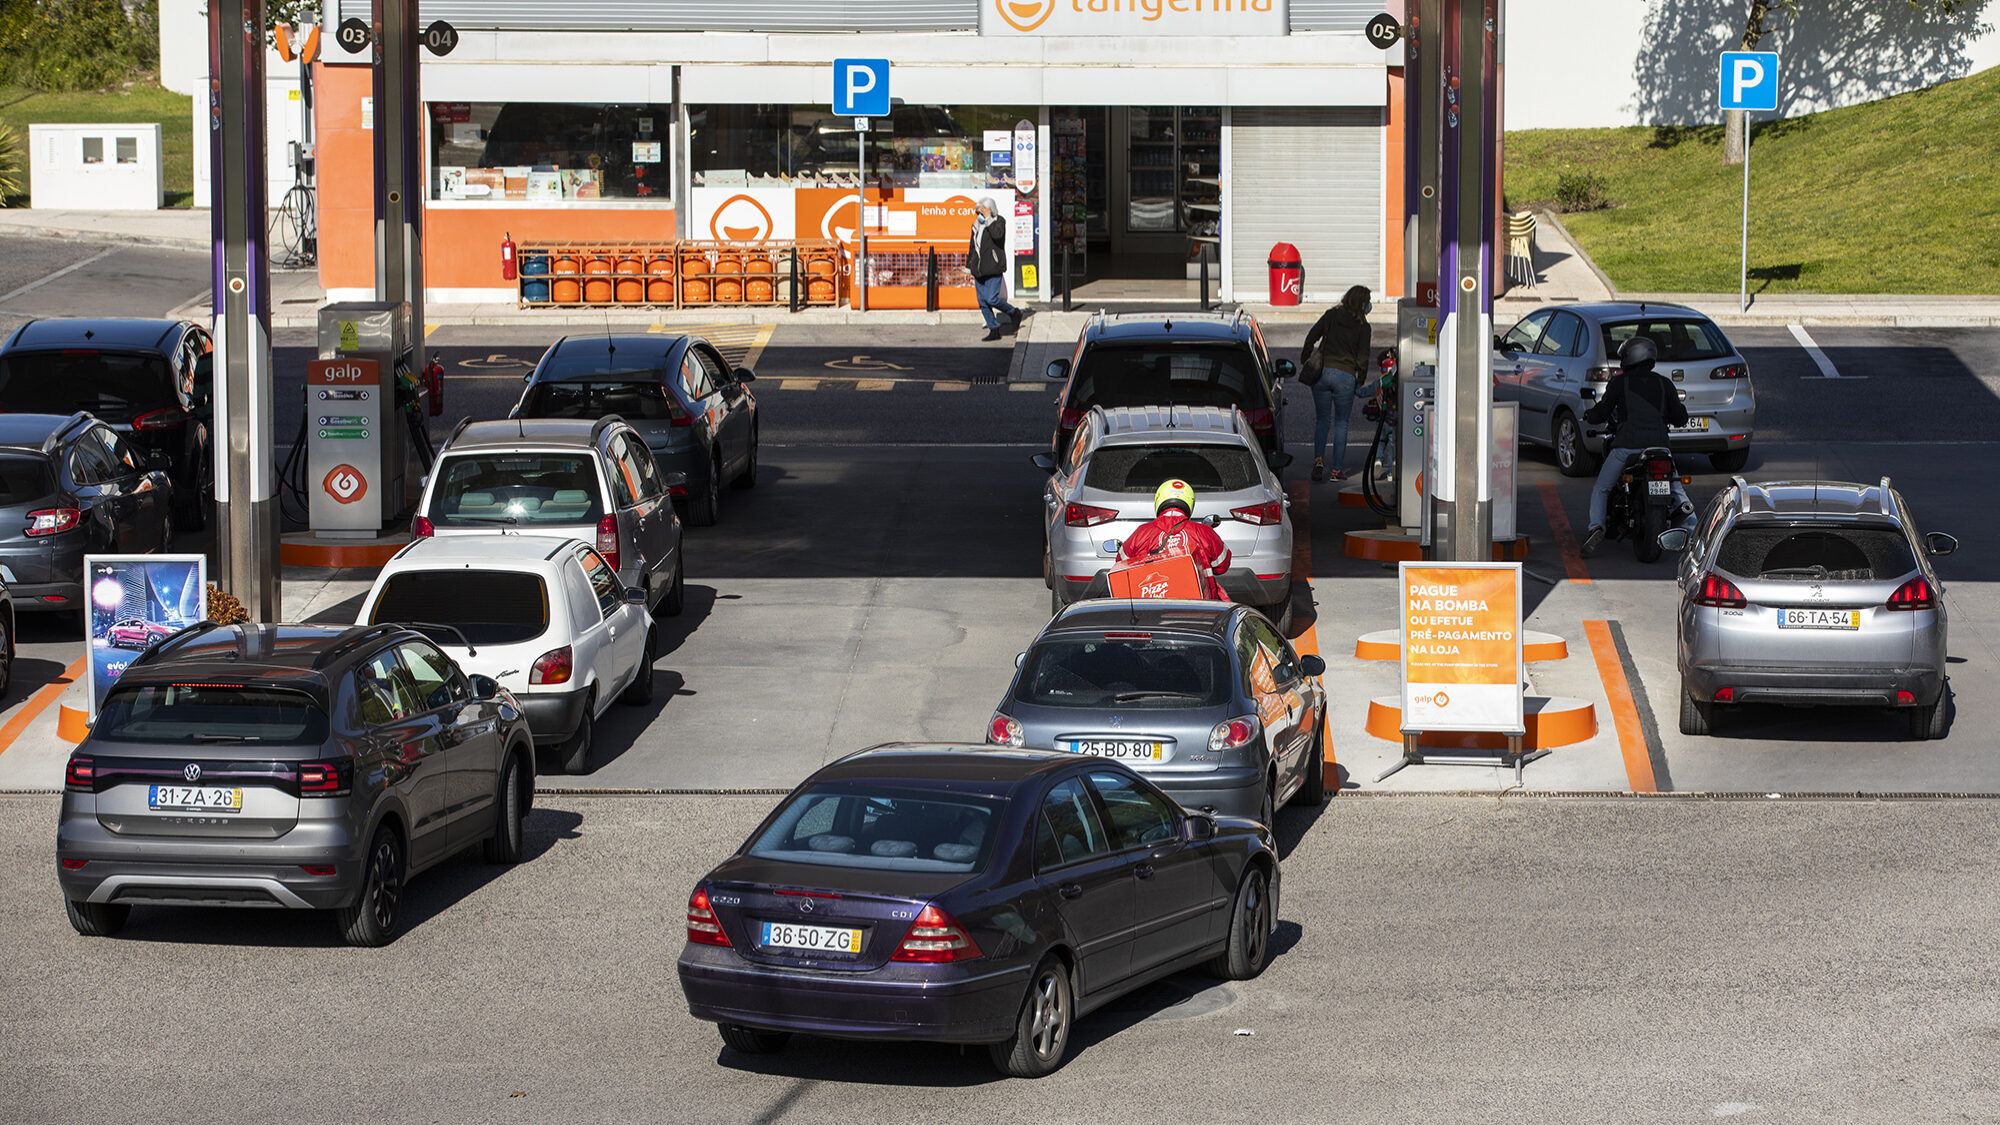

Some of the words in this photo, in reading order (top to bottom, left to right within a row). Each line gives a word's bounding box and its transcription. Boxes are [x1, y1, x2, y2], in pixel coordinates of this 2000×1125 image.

[342, 27, 365, 44] 03
[1372, 23, 1395, 40] 05
[429, 30, 452, 47] 04
[847, 65, 876, 109] P
[1733, 59, 1764, 103] P
[921, 205, 947, 216] lenha
[949, 208, 956, 216] e
[957, 206, 976, 216] carv
[325, 363, 362, 381] galp
[1141, 582, 1169, 598] Pizza
[1410, 585, 1458, 597] PAGUE
[1410, 600, 1432, 611] NA
[1435, 600, 1489, 611] BOMBA
[1410, 616, 1427, 625] OU
[1430, 616, 1474, 626] EFETUE
[1410, 628, 1512, 641] PRÉ-PAGAMENTO
[1410, 645, 1428, 654] NA
[1430, 645, 1460, 655] LOJA
[1414, 695, 1432, 704] galp
[892, 910, 913, 919] CDI
